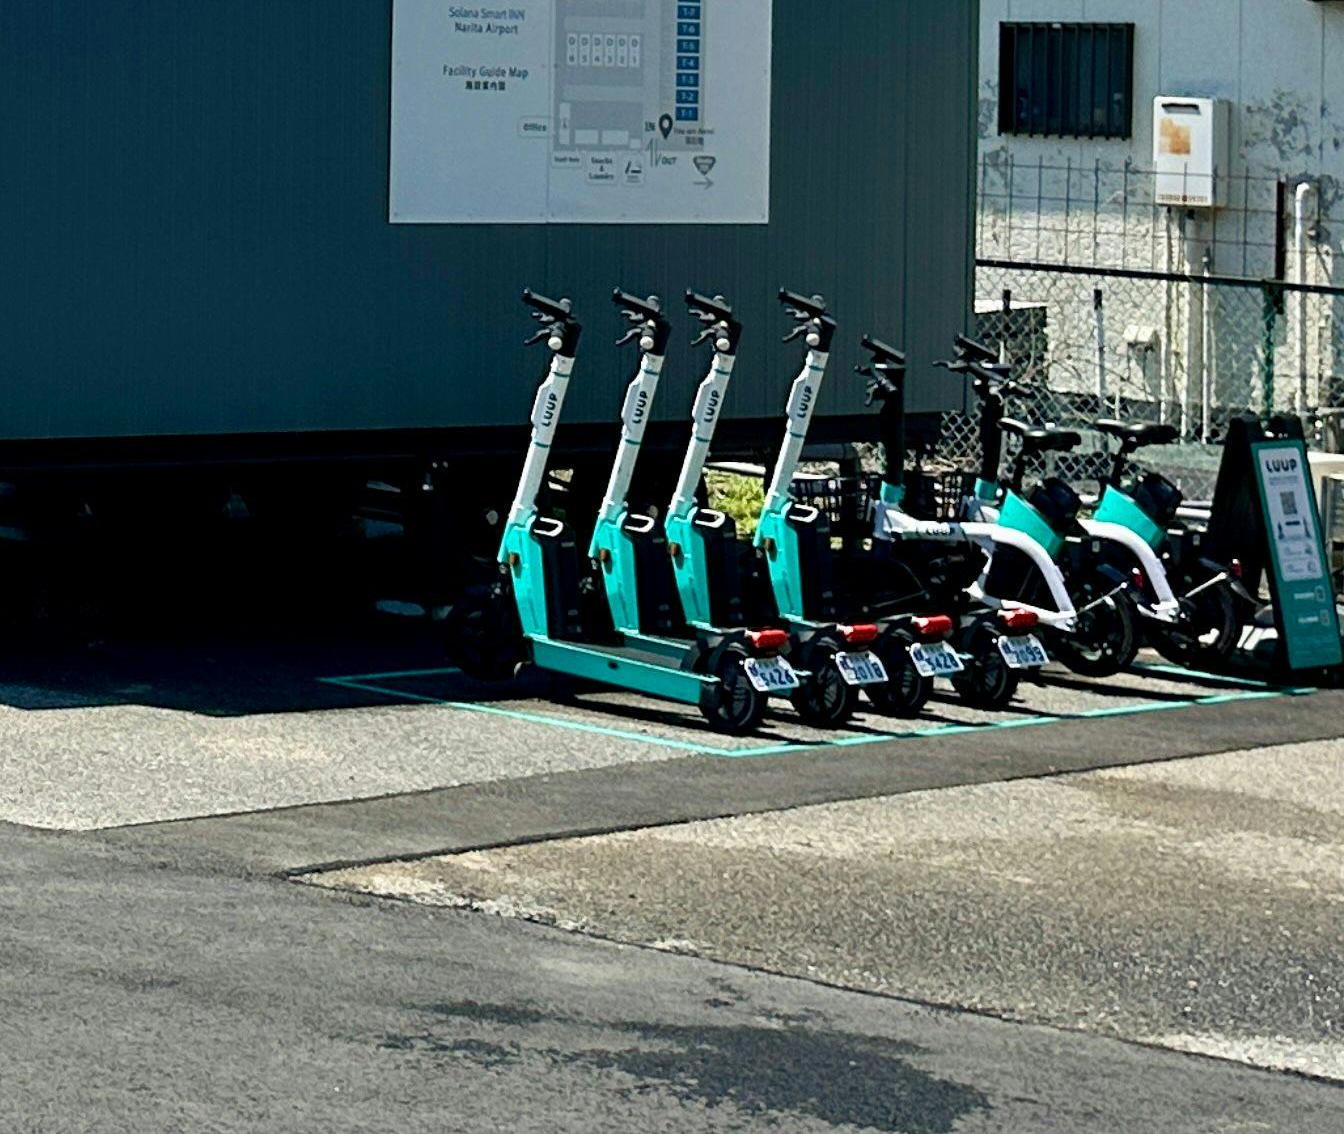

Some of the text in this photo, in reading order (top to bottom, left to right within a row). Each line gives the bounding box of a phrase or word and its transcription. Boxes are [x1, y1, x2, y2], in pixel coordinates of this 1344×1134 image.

[481, 8, 507, 20] Smart
[455, 22, 518, 36] Narita Airport
[443, 65, 529, 80] Facility Guide Map
[541, 392, 558, 427] LUUP
[631, 390, 649, 425] LUUP
[703, 389, 719, 423] LUUP
[796, 385, 813, 420] LUUP
[1265, 458, 1297, 473] LUUP
